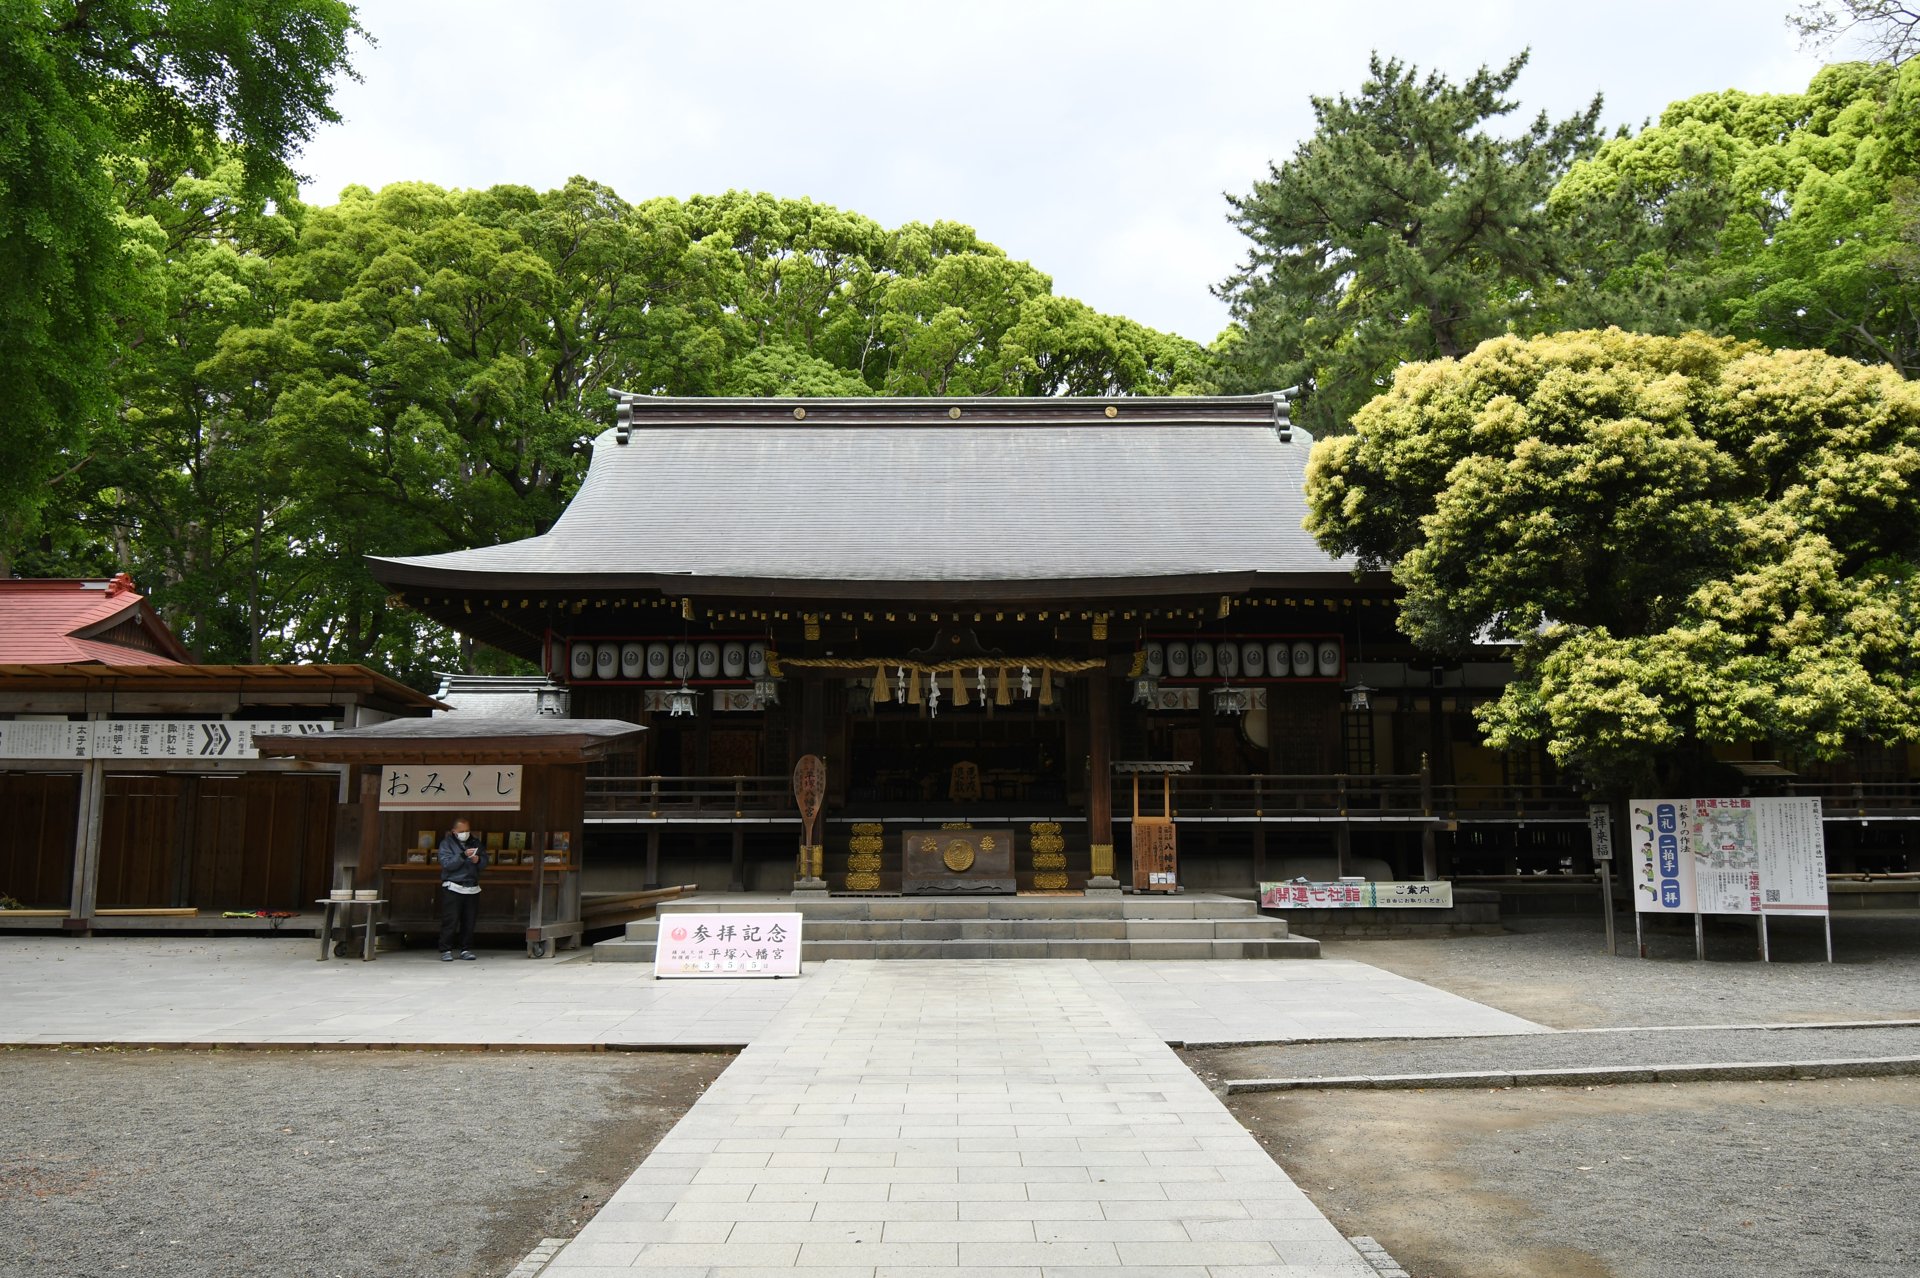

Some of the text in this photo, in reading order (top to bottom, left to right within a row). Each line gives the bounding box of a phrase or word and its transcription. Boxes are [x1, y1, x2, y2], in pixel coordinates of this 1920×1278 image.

[75, 726, 87, 756] 太子堂
[112, 723, 124, 755] 神明社
[139, 724, 150, 755] 若宮社
[166, 723, 178, 755] 諏訪社
[387, 770, 514, 796] おみくじ
[1695, 799, 1751, 808] 開運七社詣
[1658, 808, 1674, 829] 二礼
[1679, 804, 1690, 853] お参りの作法
[1592, 810, 1609, 856] 一拝来福
[1661, 840, 1676, 872] 二拍手
[1274, 886, 1361, 903] 開運七社詣
[1396, 884, 1430, 895] ご案内
[1663, 884, 1678, 904] 一拝
[692, 923, 788, 944] 参拝記念
[708, 948, 785, 960] 平塚八幡宮
